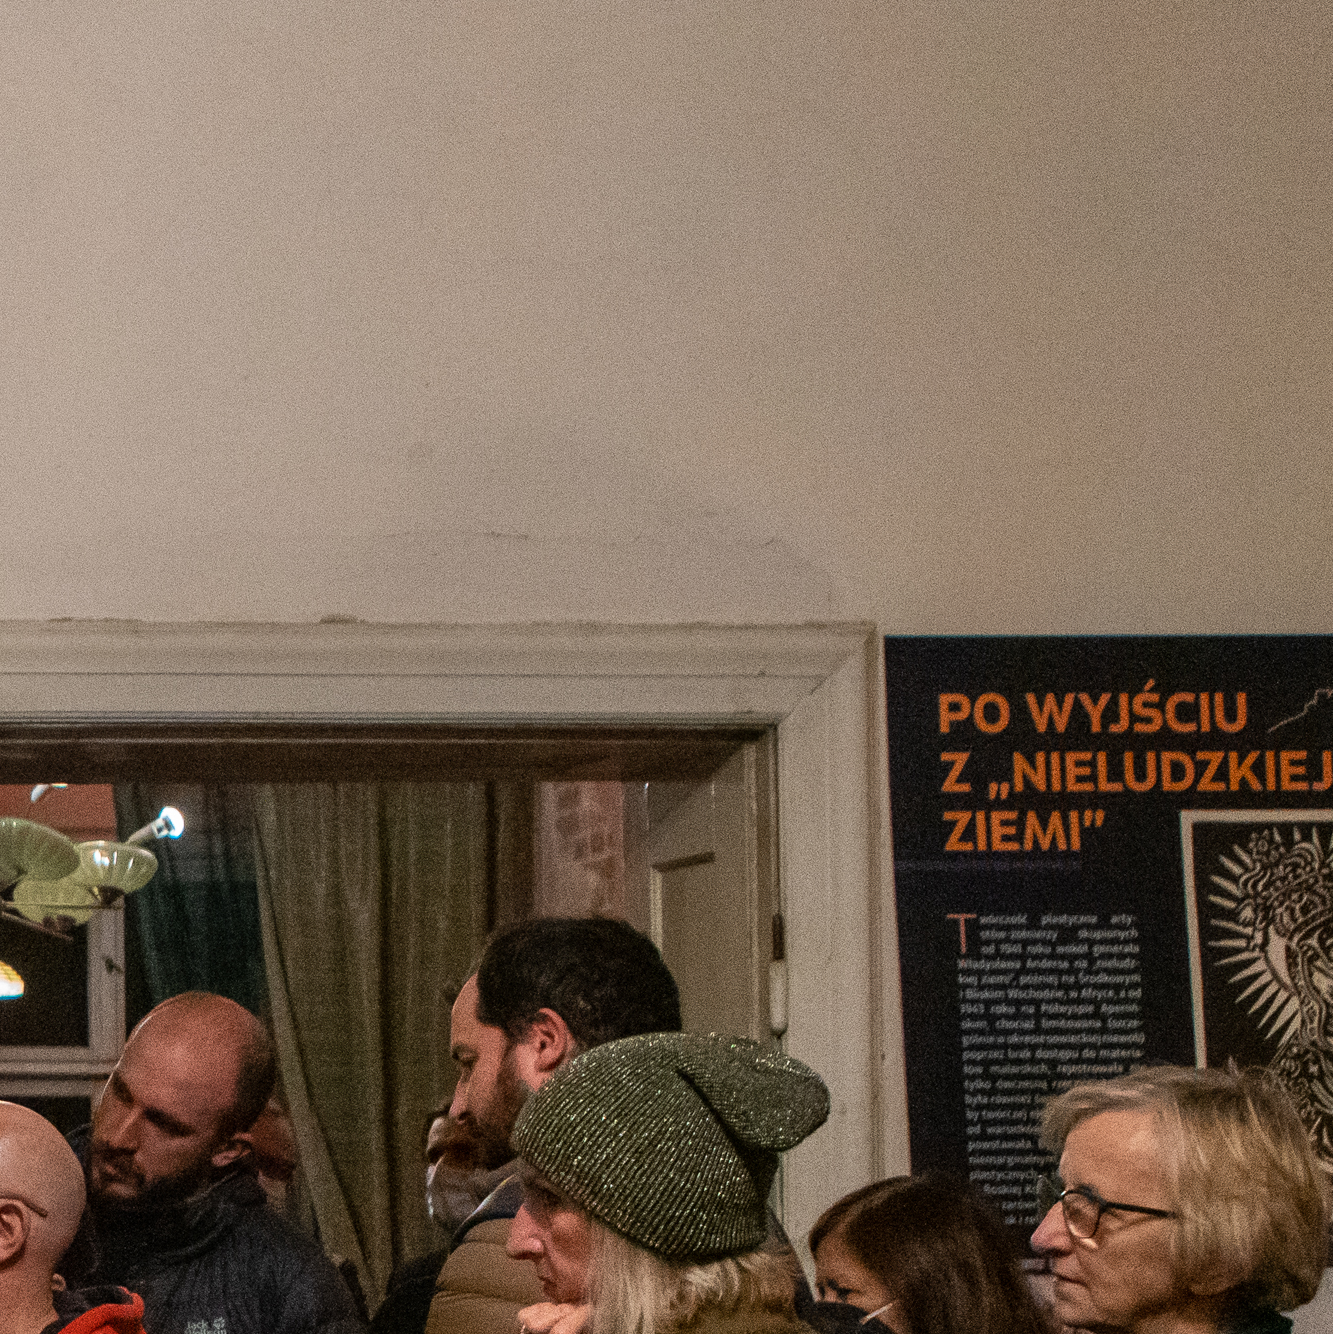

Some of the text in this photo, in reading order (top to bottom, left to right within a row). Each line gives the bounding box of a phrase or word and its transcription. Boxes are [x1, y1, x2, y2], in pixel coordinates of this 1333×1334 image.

[938, 679, 1249, 734] PO WYJŚCIU
[941, 751, 972, 794] Z
